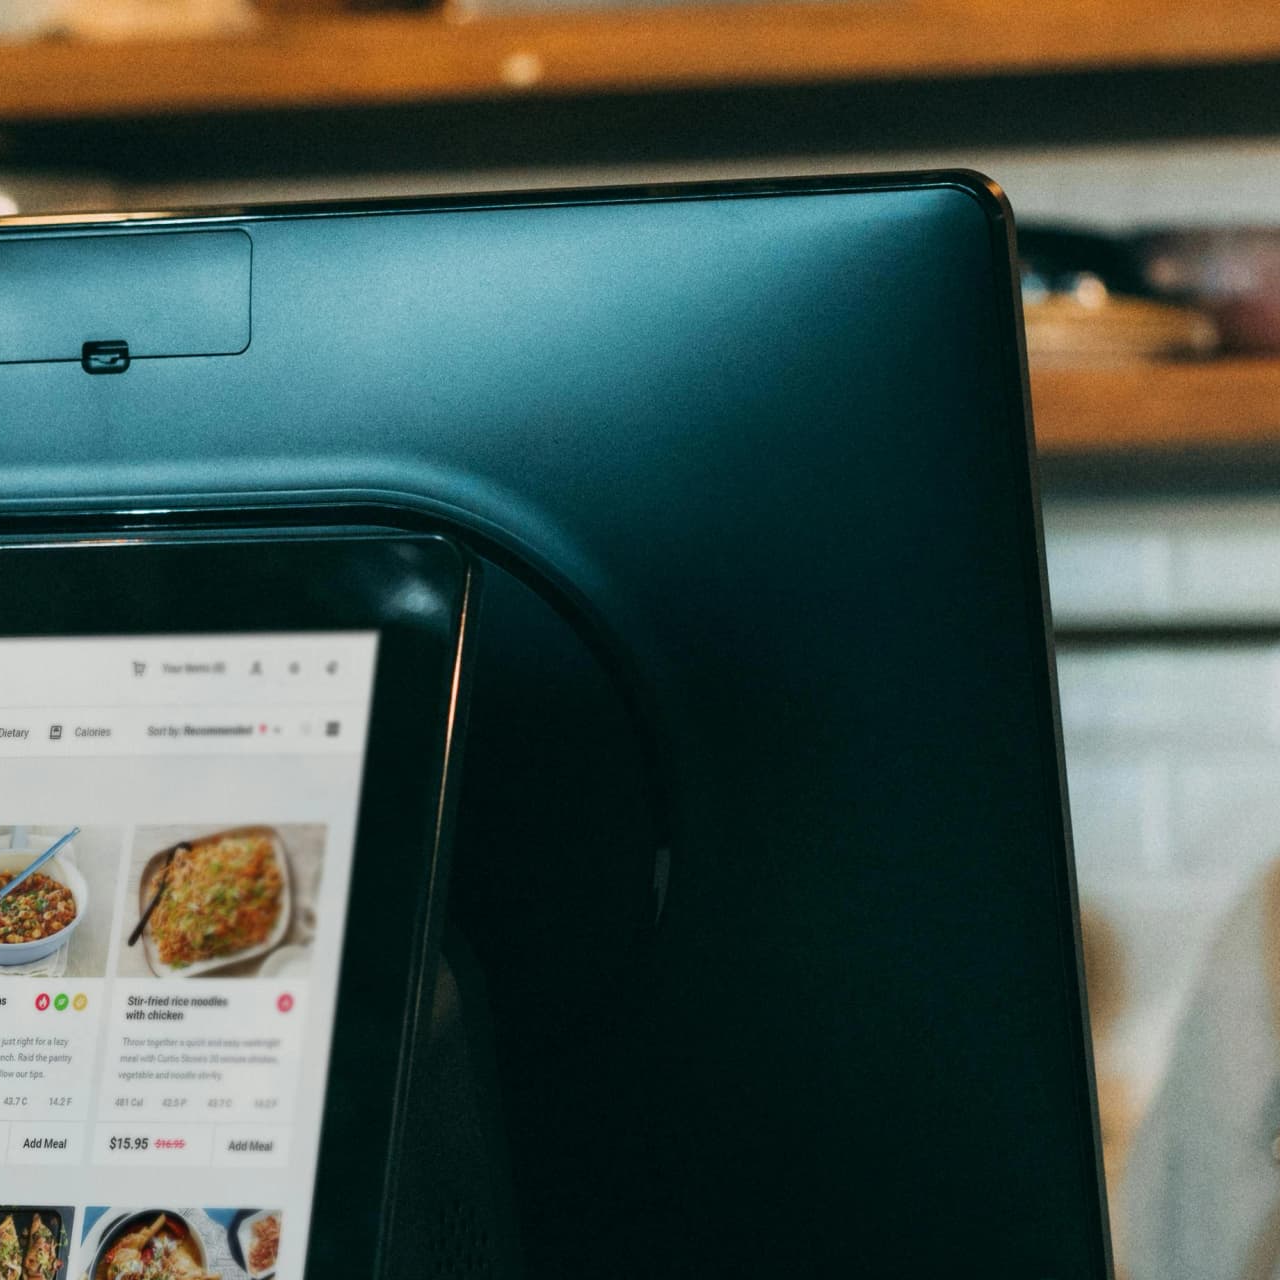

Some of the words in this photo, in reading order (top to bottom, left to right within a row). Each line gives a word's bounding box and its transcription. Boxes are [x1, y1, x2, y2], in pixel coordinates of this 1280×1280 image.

[74, 726, 111, 737] Calories
[147, 725, 168, 736] Sort
[127, 994, 170, 1006] Stir-fried
[168, 995, 190, 1006] rice
[189, 995, 228, 1007] noodles
[125, 1008, 146, 1020] with
[146, 1008, 184, 1021] chicken
[0, 1037, 16, 1048] just
[15, 1036, 34, 1048] right
[34, 1036, 47, 1046] for
[46, 1038, 52, 1046] a
[52, 1036, 69, 1048] lazy
[16, 1051, 35, 1062] Raid
[34, 1052, 48, 1063] the
[47, 1053, 72, 1065] pantry
[14, 1070, 28, 1079] our
[22, 1137, 43, 1149] Add
[43, 1137, 67, 1149] Meal
[108, 1135, 149, 1150] $15.95
[227, 1139, 249, 1152] Add
[247, 1139, 273, 1152] Meal
